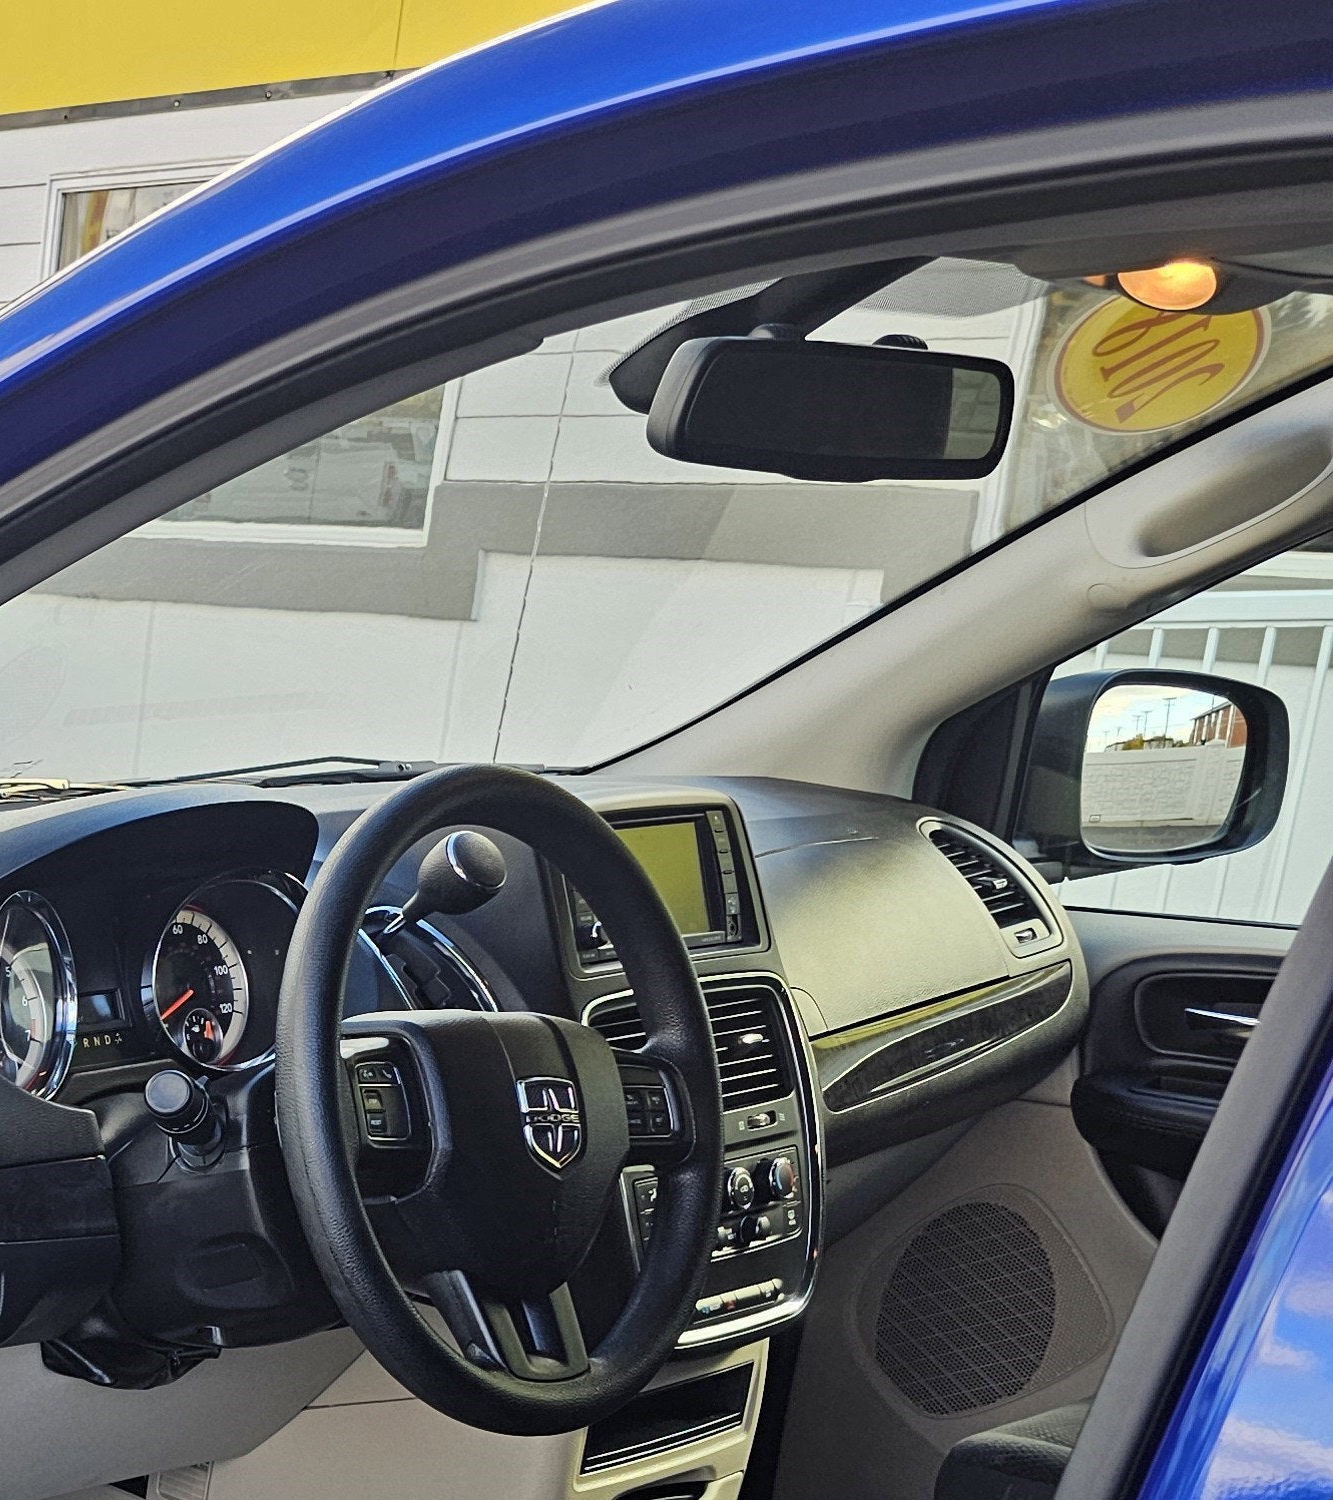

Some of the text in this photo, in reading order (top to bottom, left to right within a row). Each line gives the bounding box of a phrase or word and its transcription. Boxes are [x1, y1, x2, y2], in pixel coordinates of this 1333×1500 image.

[172, 924, 184, 935] 60
[197, 934, 209, 945] 80
[213, 964, 229, 976] 100
[21, 996, 28, 1007] 6
[219, 1003, 233, 1014] 120
[82, 1034, 112, 1048] R N D
